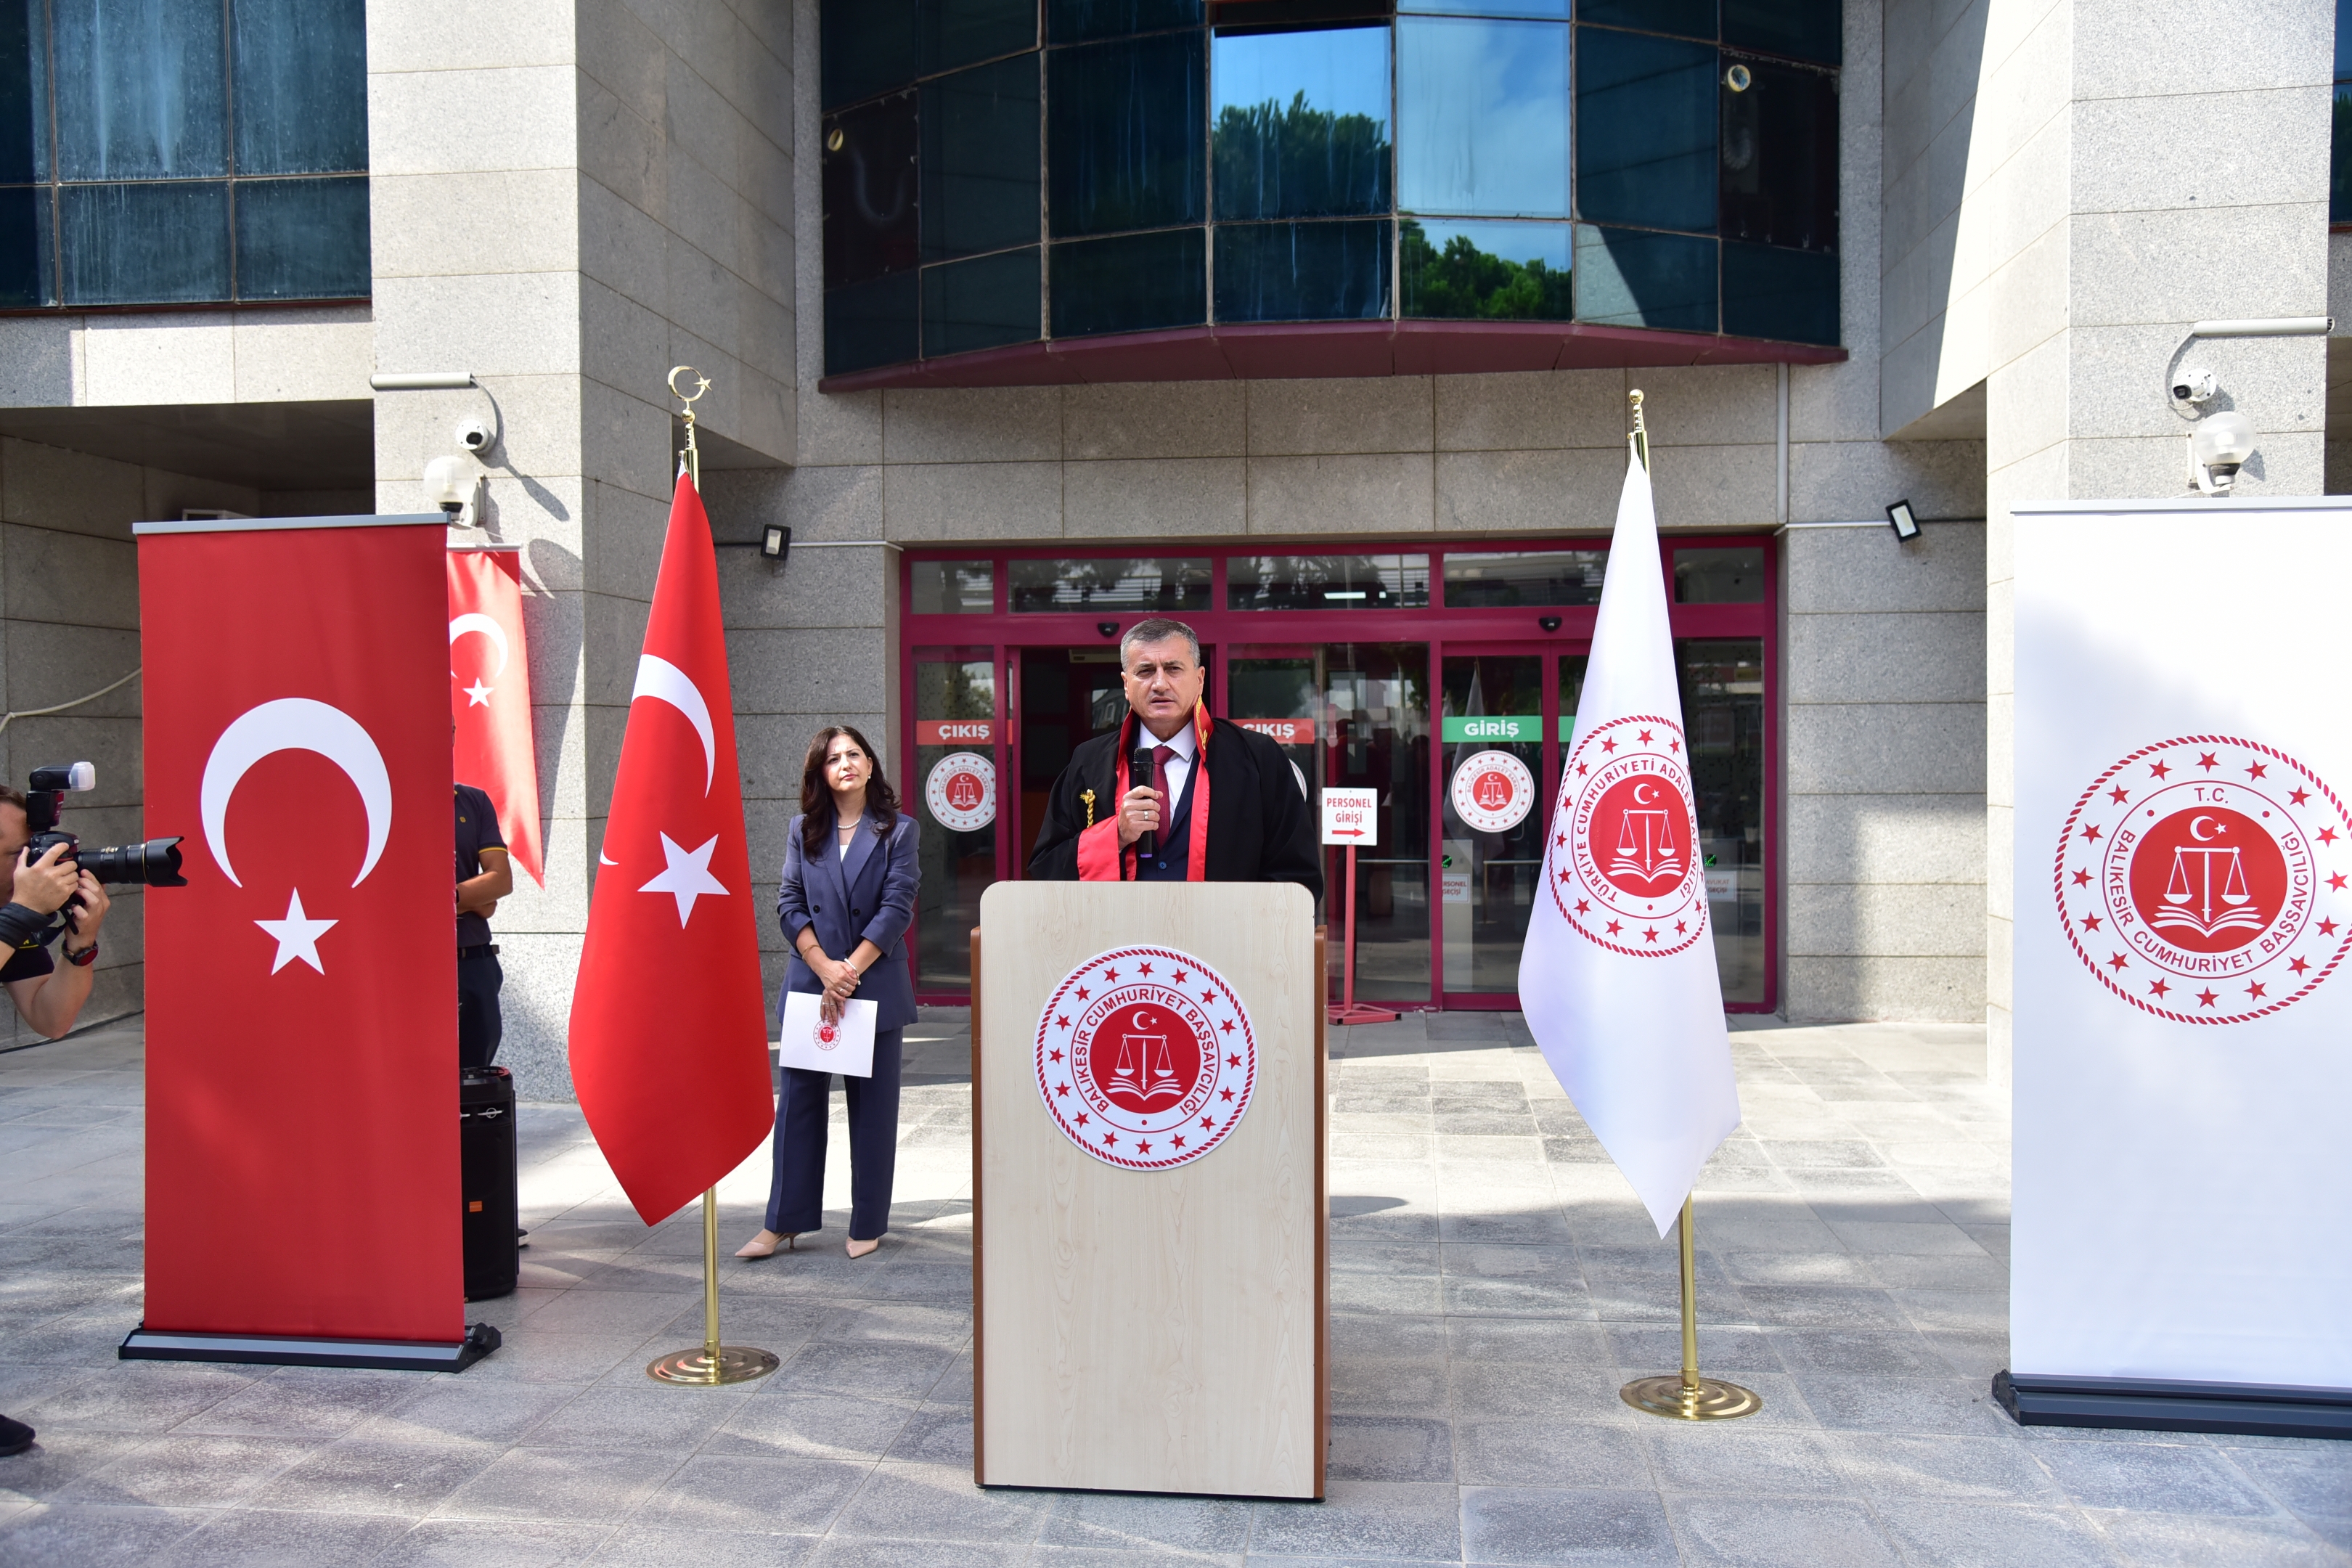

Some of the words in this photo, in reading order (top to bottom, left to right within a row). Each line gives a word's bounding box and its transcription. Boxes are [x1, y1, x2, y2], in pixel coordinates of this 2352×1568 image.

[938, 724, 990, 740] ÇIKIŞ
[1464, 719, 1519, 738] GİRİŞ
[1326, 798, 1372, 808] PERSONEL
[1577, 757, 1654, 835] CUMHURİYETİ
[1659, 763, 1692, 809] ADALET
[2194, 787, 2229, 804] T.C.
[1336, 810, 1363, 825] GİRİŞİ
[1577, 841, 1617, 902] TÜRKİYE
[1679, 814, 1697, 899] BAKANLIĞI
[2109, 829, 2136, 928] BALIKESİR
[2133, 930, 2253, 972] CUMHURİYET
[2259, 830, 2308, 954] BAŞSAVCILIĞI
[1086, 986, 1187, 1026] CUMHURİYET
[1074, 1029, 1110, 1113] BALIKESİR
[1179, 1008, 1216, 1116] BAŞSAVCILIĞI
